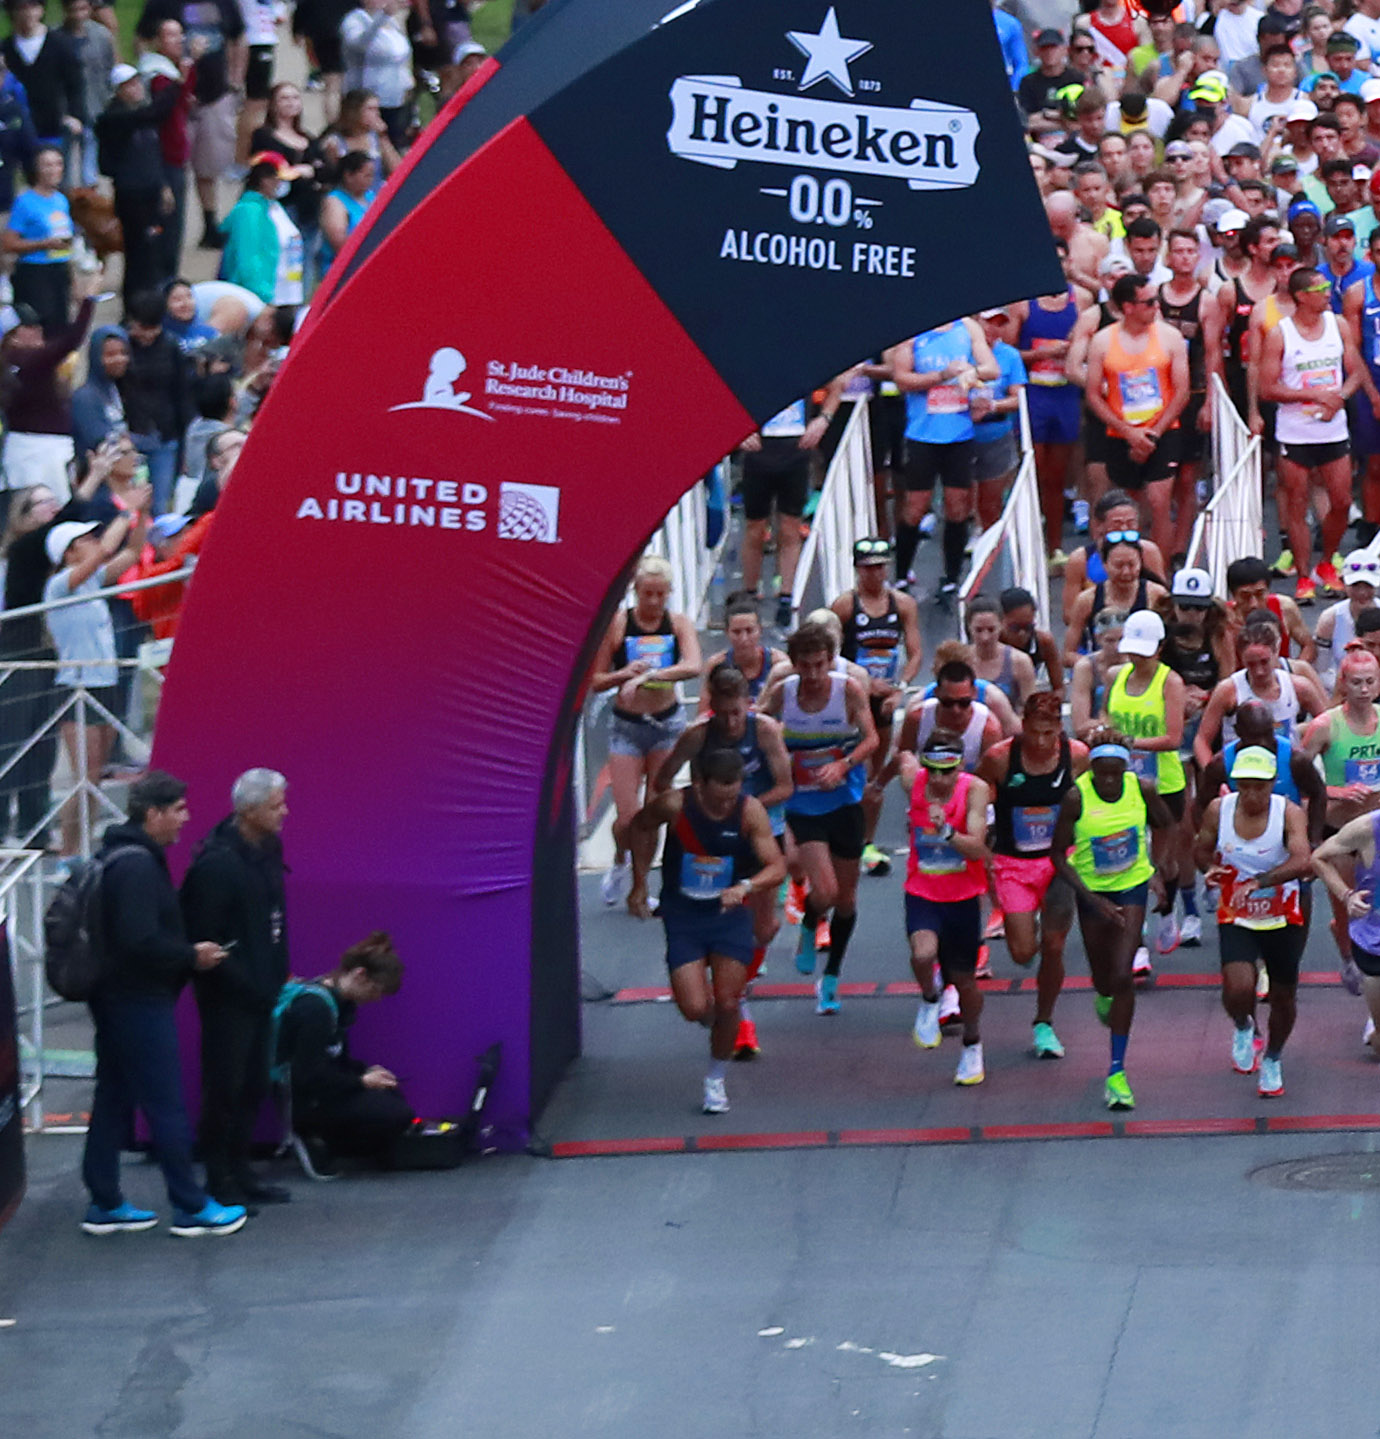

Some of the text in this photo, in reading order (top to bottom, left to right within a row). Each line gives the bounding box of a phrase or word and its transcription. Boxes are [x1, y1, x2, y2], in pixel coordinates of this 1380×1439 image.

[689, 92, 958, 170] Heineken
[719, 228, 917, 278] ALCOHOL FREE
[484, 379, 630, 411] Research Hospital
[335, 471, 488, 506] UNITED
[295, 496, 488, 532] AIRLINES
